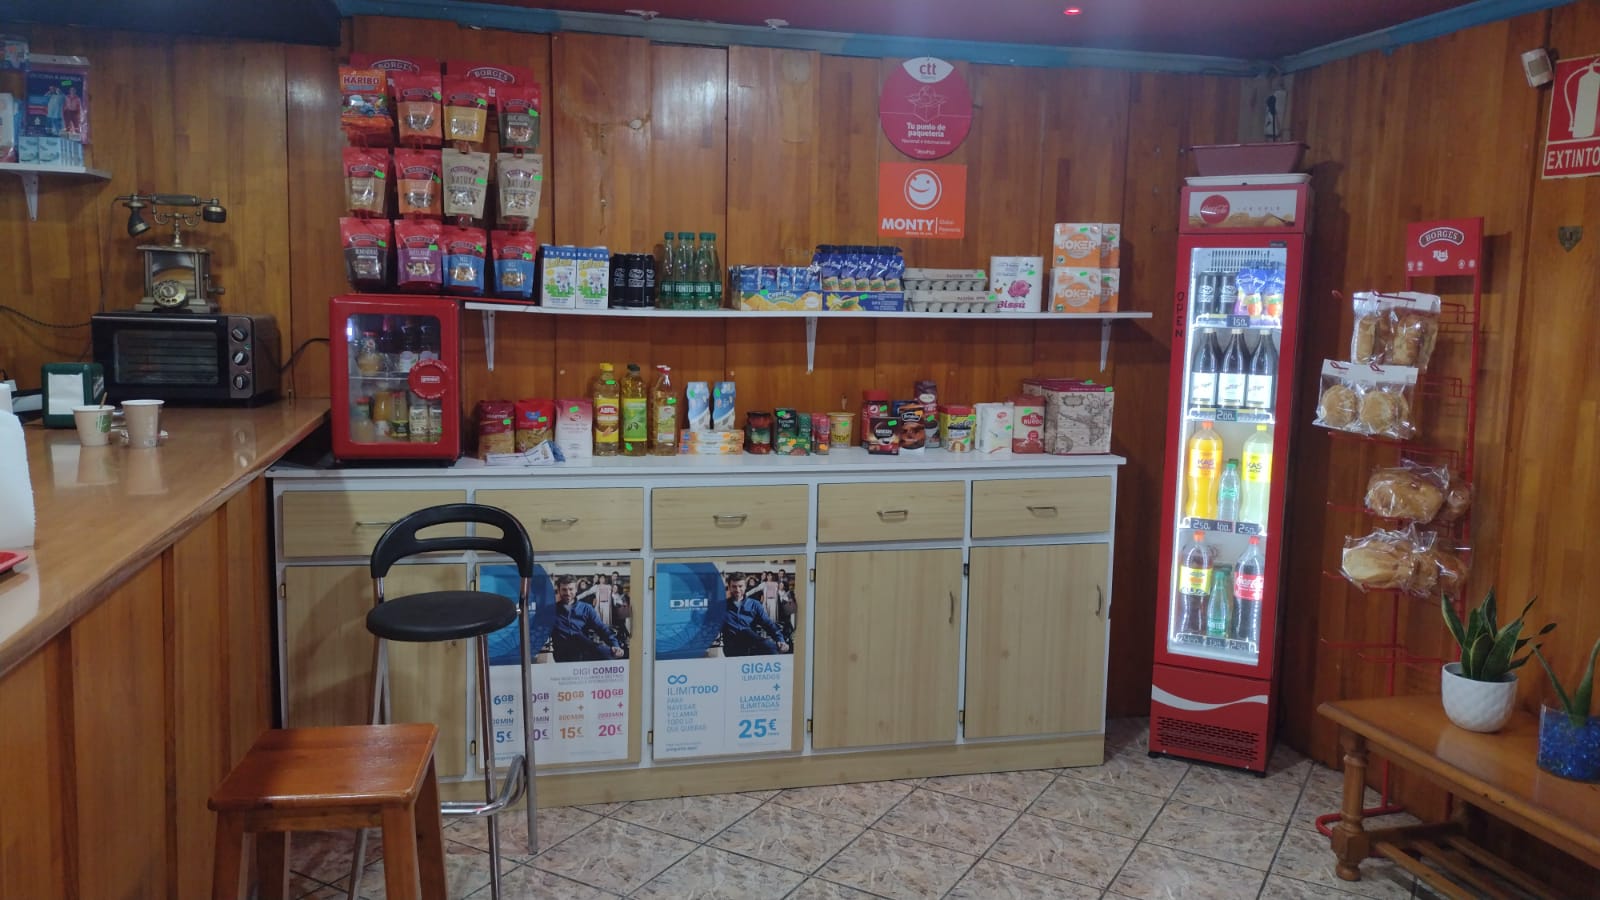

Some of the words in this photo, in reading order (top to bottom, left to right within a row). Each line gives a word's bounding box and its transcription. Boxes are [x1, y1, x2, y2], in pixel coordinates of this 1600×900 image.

[919, 63, 937, 75] ctt
[343, 76, 380, 85] HARIBO
[473, 69, 509, 81] BORGES
[906, 122, 915, 130] Tu
[916, 123, 936, 132] punto
[937, 123, 946, 131] de
[881, 218, 934, 231] MONTY
[1425, 230, 1459, 242] BORGES
[1058, 240, 1097, 250] JOKER
[1058, 289, 1096, 298] JOKER
[1175, 291, 1185, 338] OPEN
[670, 598, 709, 608] DIGI
[573, 668, 592, 676] DIGI
[592, 665, 625, 675] COMBO
[741, 662, 782, 674] GIGAS
[667, 685, 719, 696] ILIMITODO
[740, 694, 781, 703] LLAMADAS
[740, 701, 780, 710] ILIMITADAS
[738, 718, 777, 739] 25€
